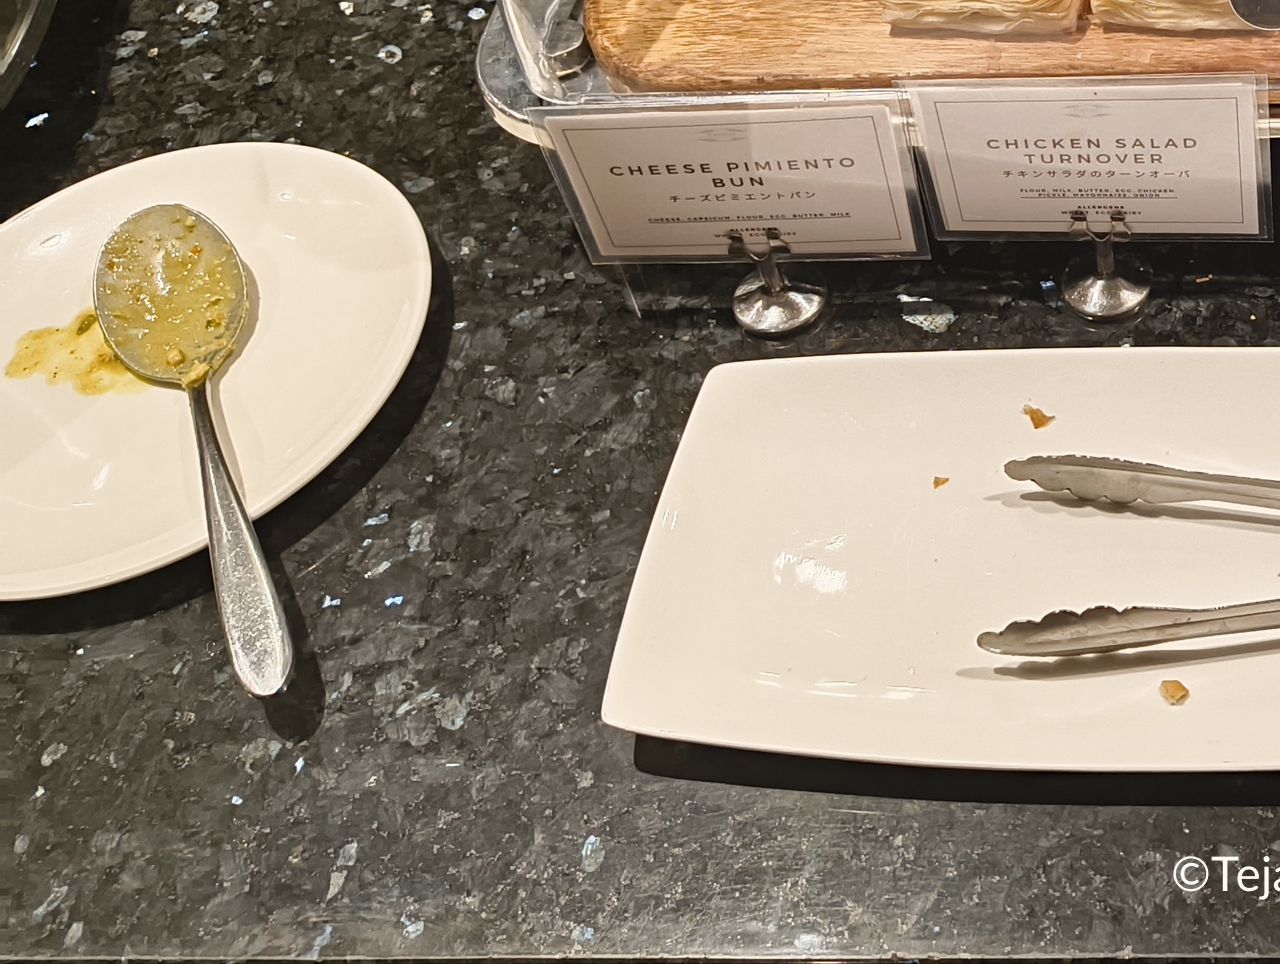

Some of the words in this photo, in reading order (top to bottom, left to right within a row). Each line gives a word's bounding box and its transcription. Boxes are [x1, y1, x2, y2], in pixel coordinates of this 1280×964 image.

[986, 137, 1101, 149] CHICKEN
[1115, 137, 1197, 149] SALAD
[1023, 153, 1163, 164] TURNOVER
[609, 163, 713, 177] CHEESE
[726, 157, 855, 173] PIMIENTO
[712, 176, 764, 188] BUN
